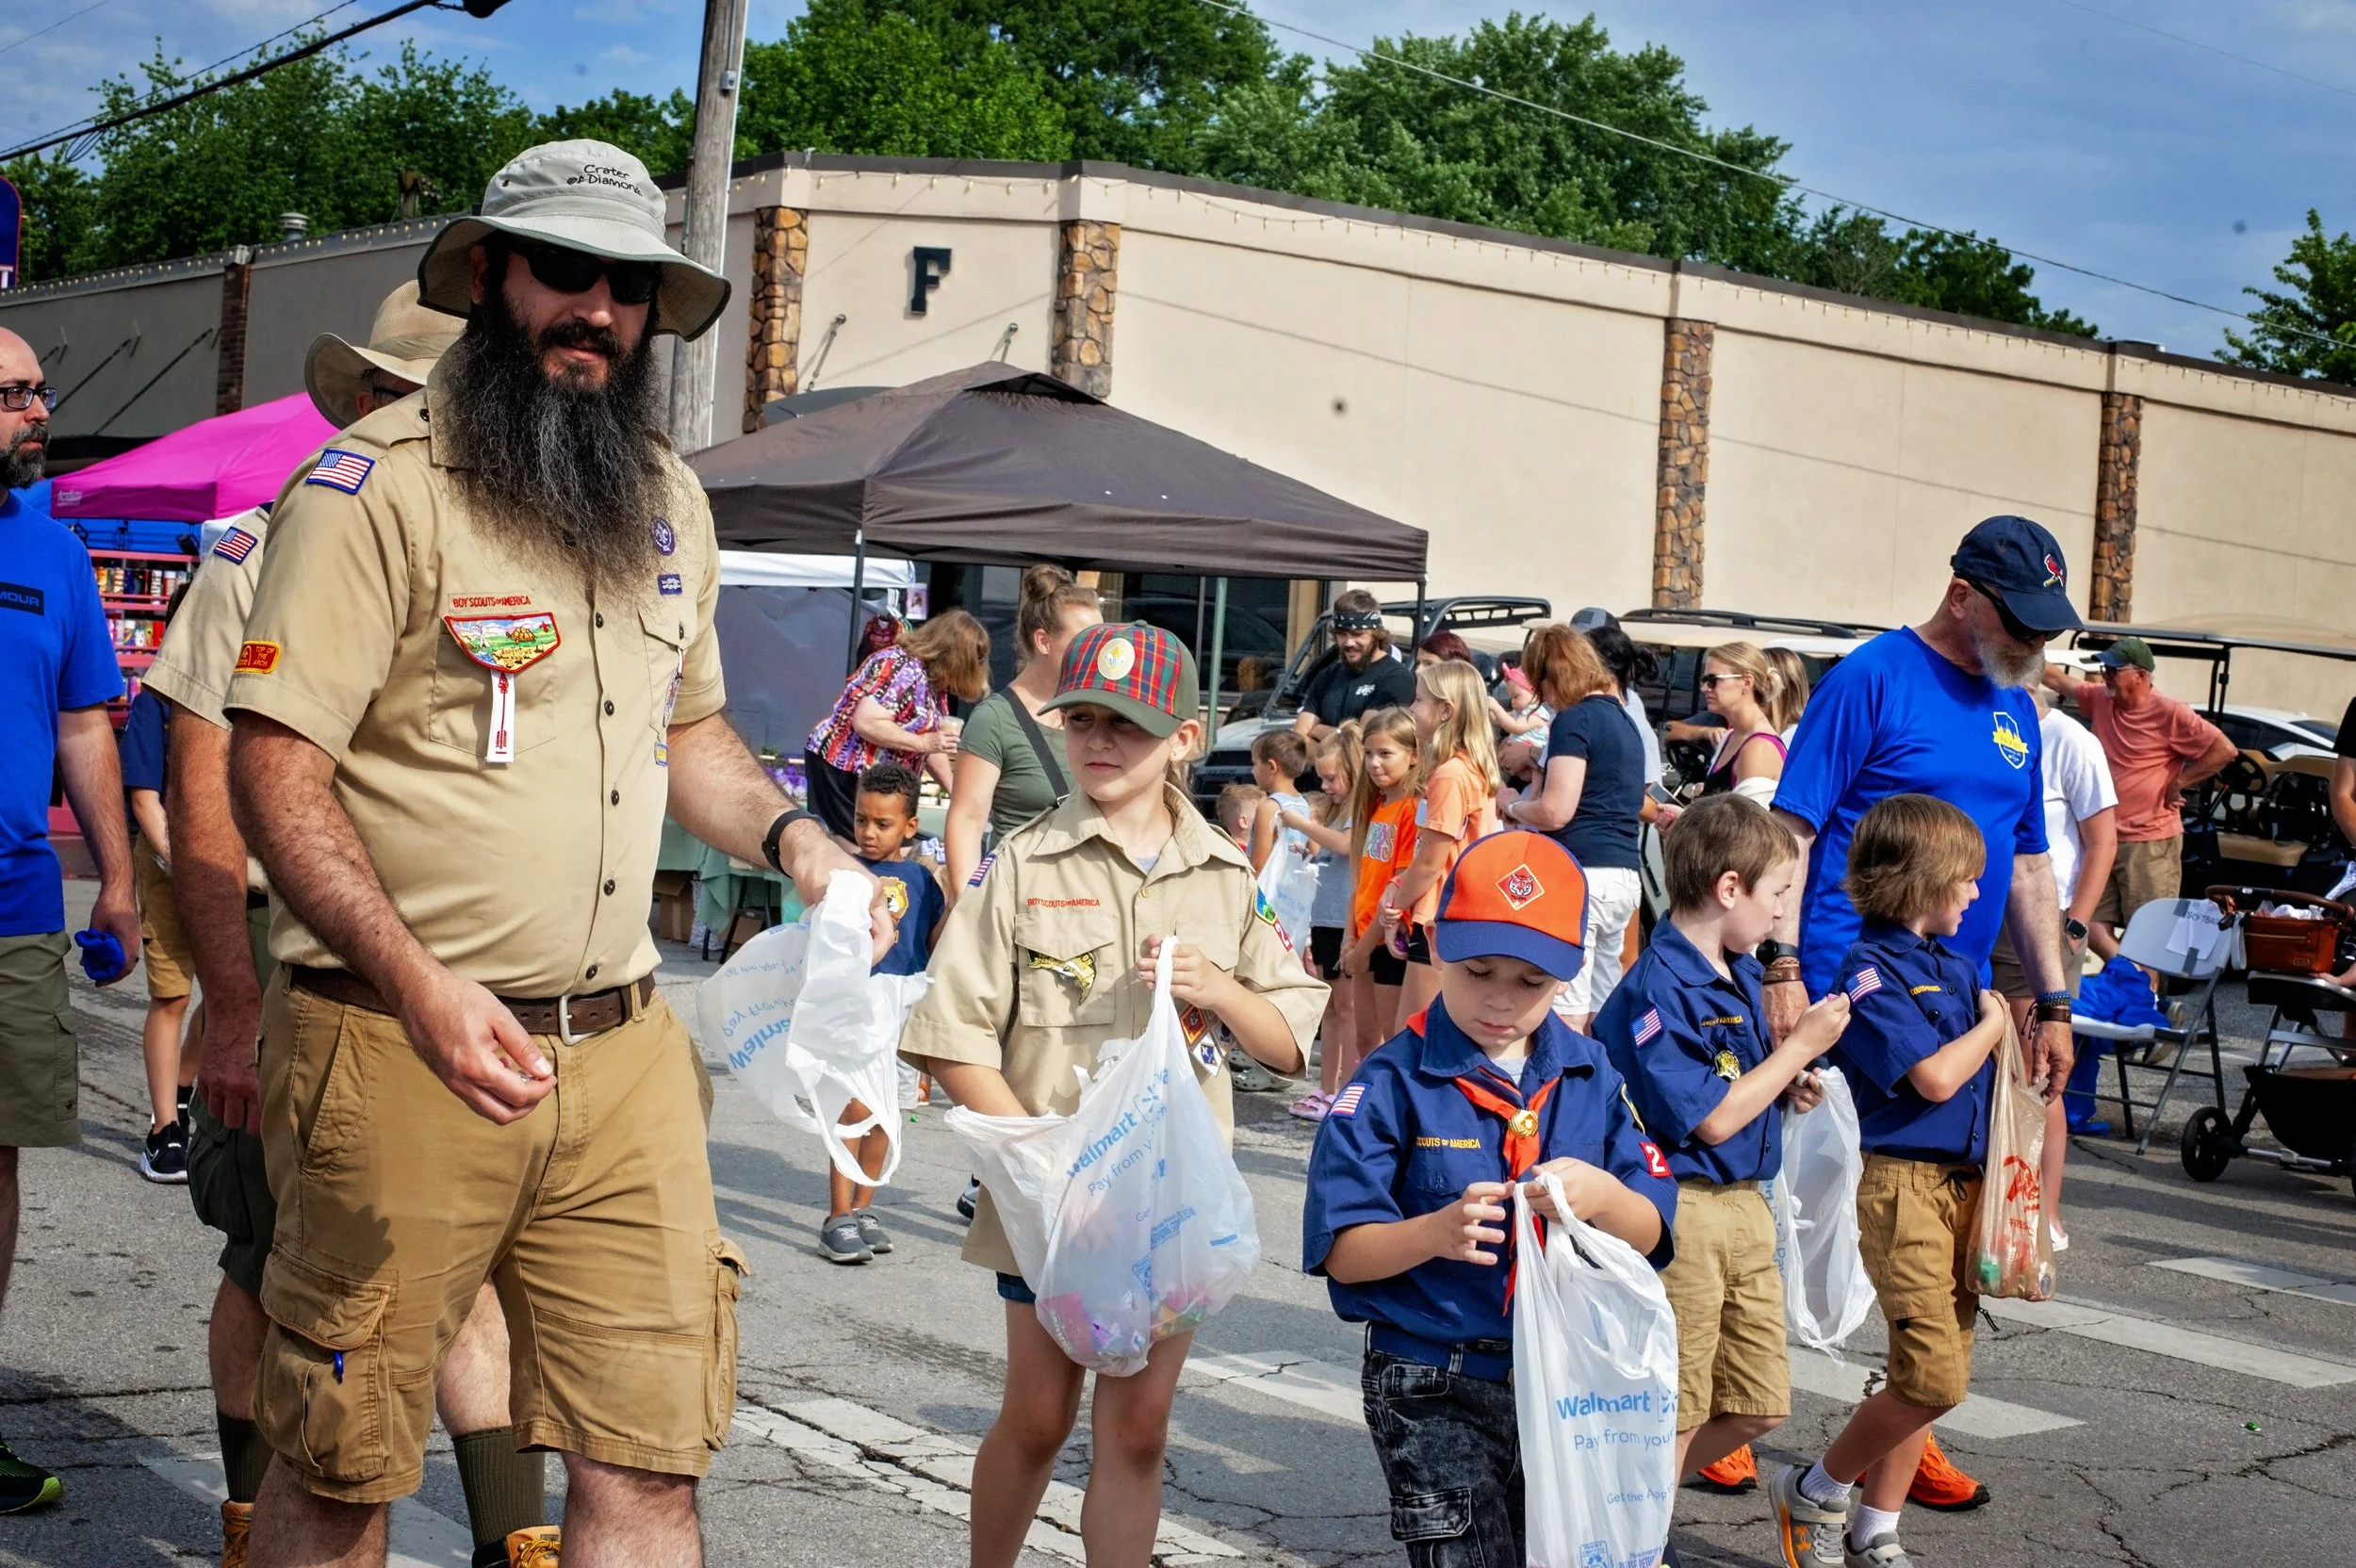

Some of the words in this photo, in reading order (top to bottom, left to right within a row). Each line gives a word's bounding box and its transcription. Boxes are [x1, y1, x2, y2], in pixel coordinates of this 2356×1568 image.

[583, 164, 630, 180] Crater
[910, 246, 952, 315] F
[452, 596, 467, 608] BOY
[468, 596, 496, 608] SCOUTS
[501, 595, 532, 606] AMERICA
[1027, 897, 1041, 906] BOY
[1041, 898, 1066, 907] SCOUTS
[1071, 898, 1101, 906] AMERICA
[1274, 923, 1290, 947] 2
[1449, 1138, 1481, 1149] AMERICA
[1645, 1145, 1666, 1172] 2
[1088, 1173, 1113, 1197] Pay
[1111, 1148, 1144, 1177] from
[1556, 1390, 1651, 1420] Walmart
[1574, 1433, 1600, 1452] Pay
[1603, 1428, 1640, 1446] from
[1607, 1493, 1626, 1504] Get
[1628, 1490, 1644, 1502] the
[1646, 1488, 1667, 1503] App
